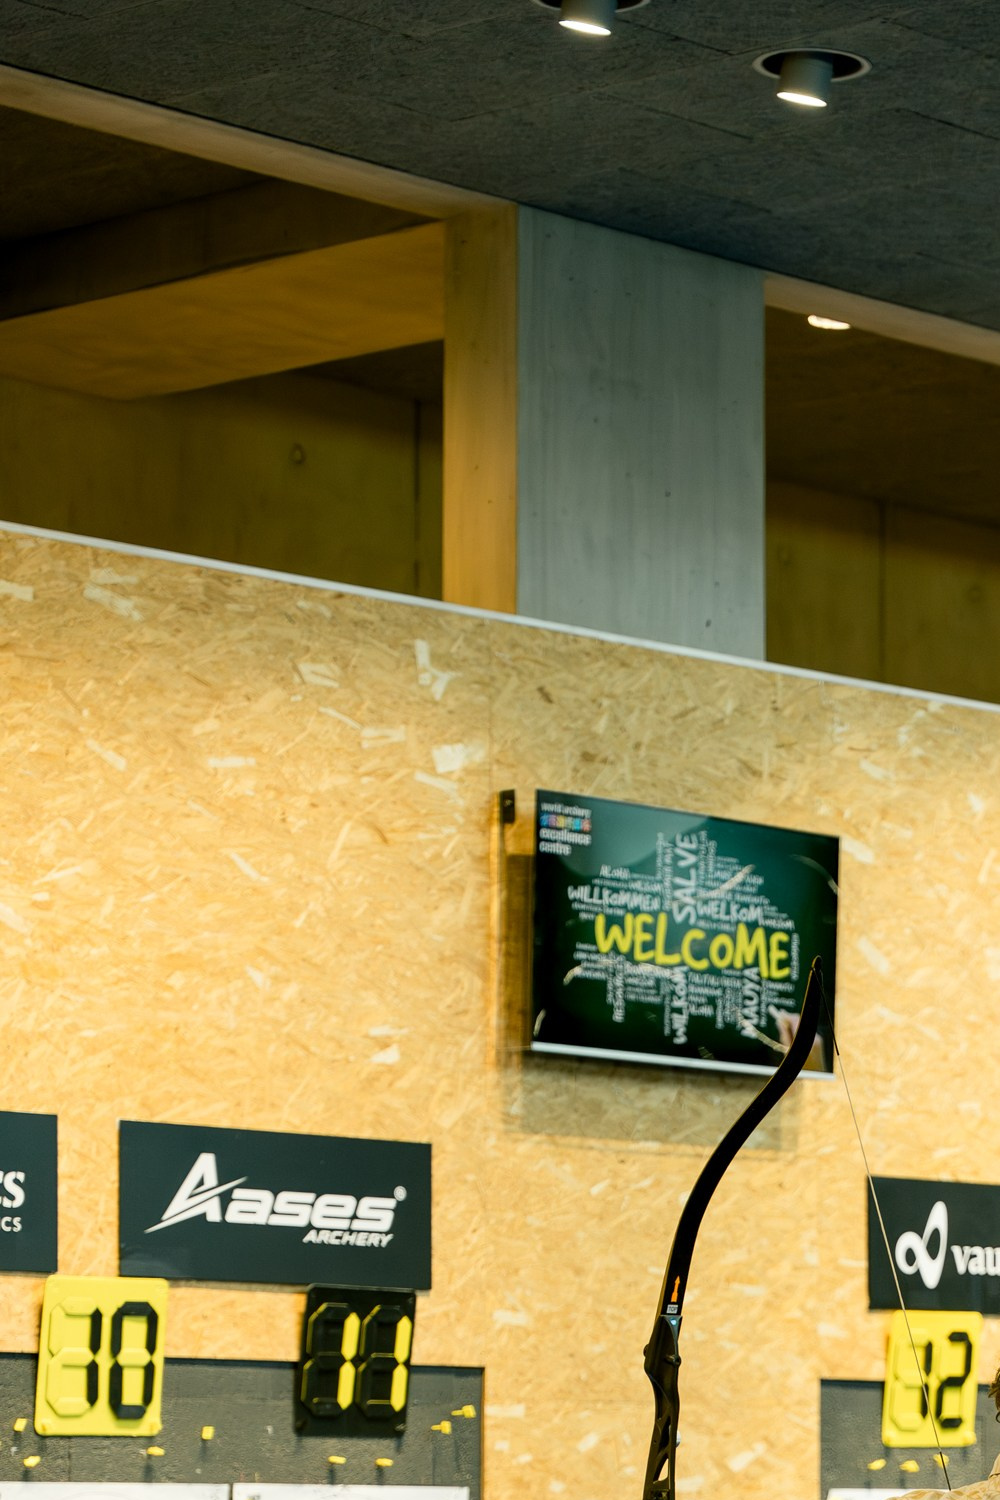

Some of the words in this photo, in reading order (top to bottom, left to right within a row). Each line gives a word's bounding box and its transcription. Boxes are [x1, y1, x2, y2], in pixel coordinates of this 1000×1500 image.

[539, 828, 592, 847] excellence
[539, 841, 572, 856] centre
[671, 832, 699, 926] SALVE
[697, 898, 763, 923] WELKOM
[594, 911, 791, 979] WELCOME
[0, 1170, 26, 1209] S
[303, 1229, 393, 1248] ARCHERY
[86, 1302, 158, 1419] 10
[337, 1312, 411, 1412] 11
[921, 1332, 972, 1428] 12
